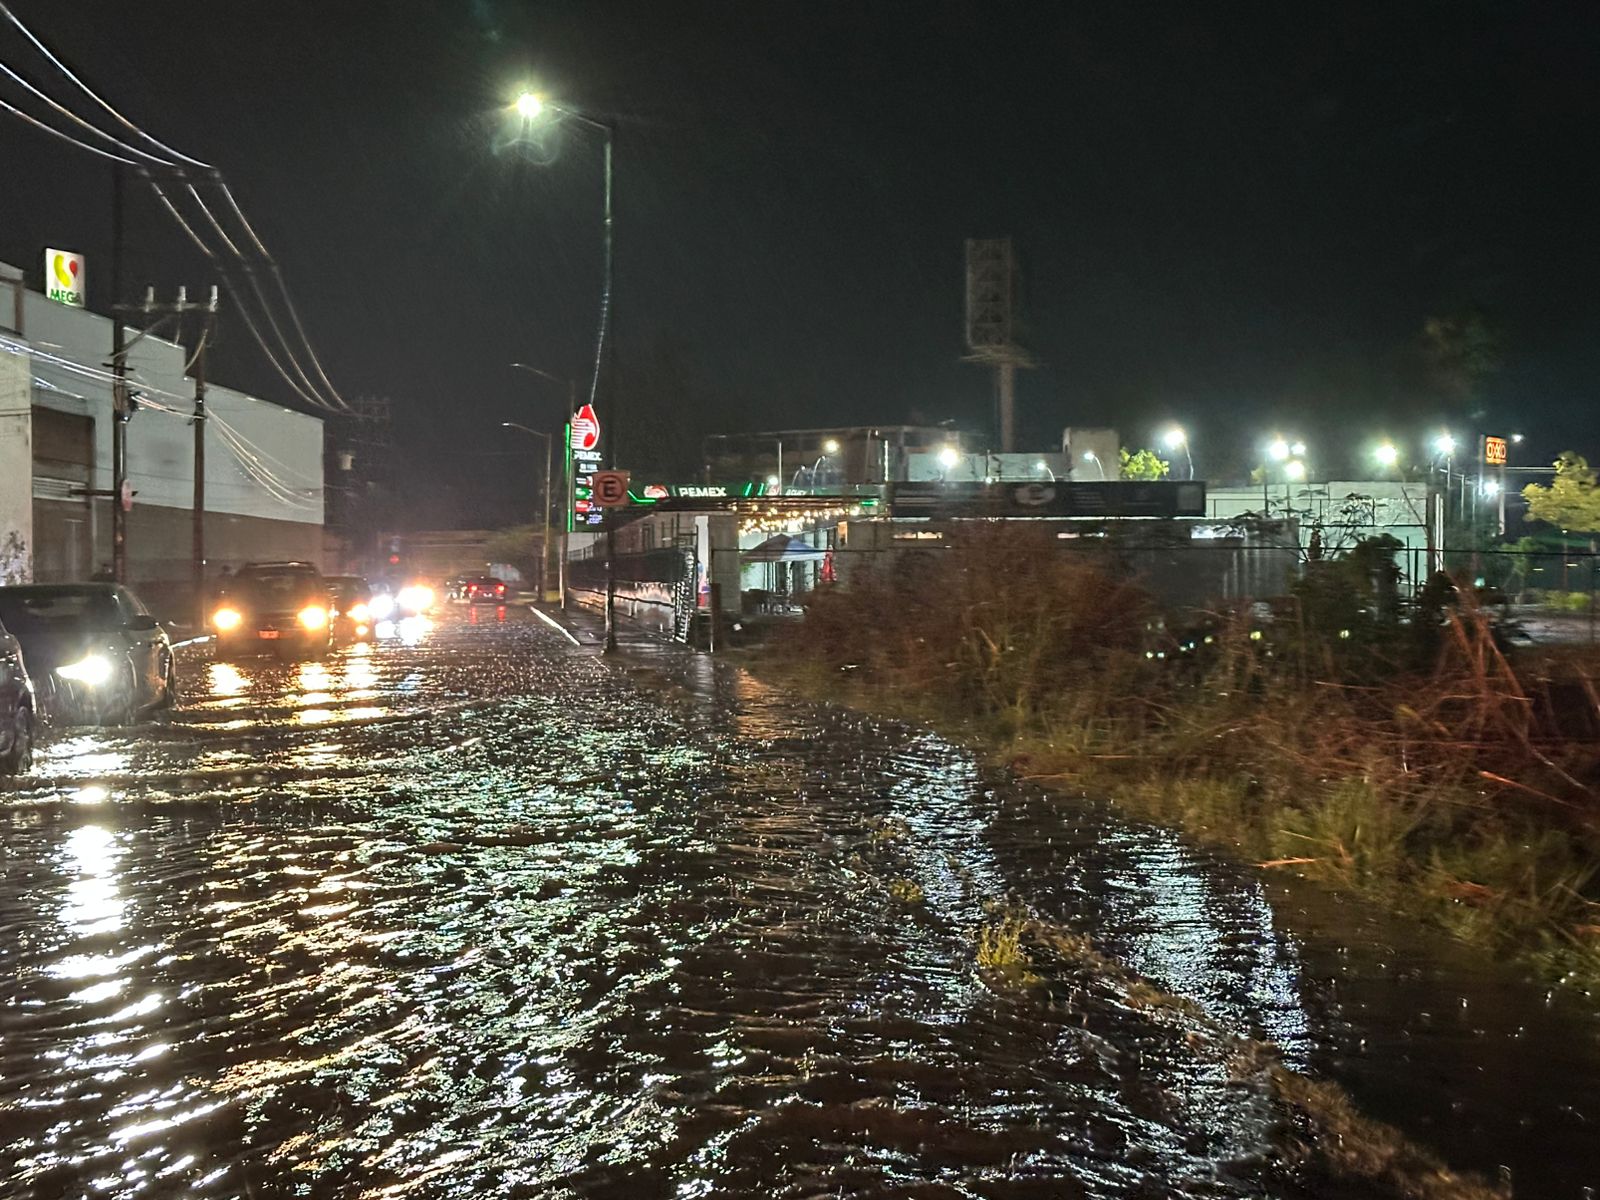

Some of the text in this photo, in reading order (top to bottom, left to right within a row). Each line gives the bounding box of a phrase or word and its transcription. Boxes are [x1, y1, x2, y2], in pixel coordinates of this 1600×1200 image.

[50, 288, 82, 304] MEGA
[604, 480, 616, 497] E
[679, 487, 727, 497] PEMEX
